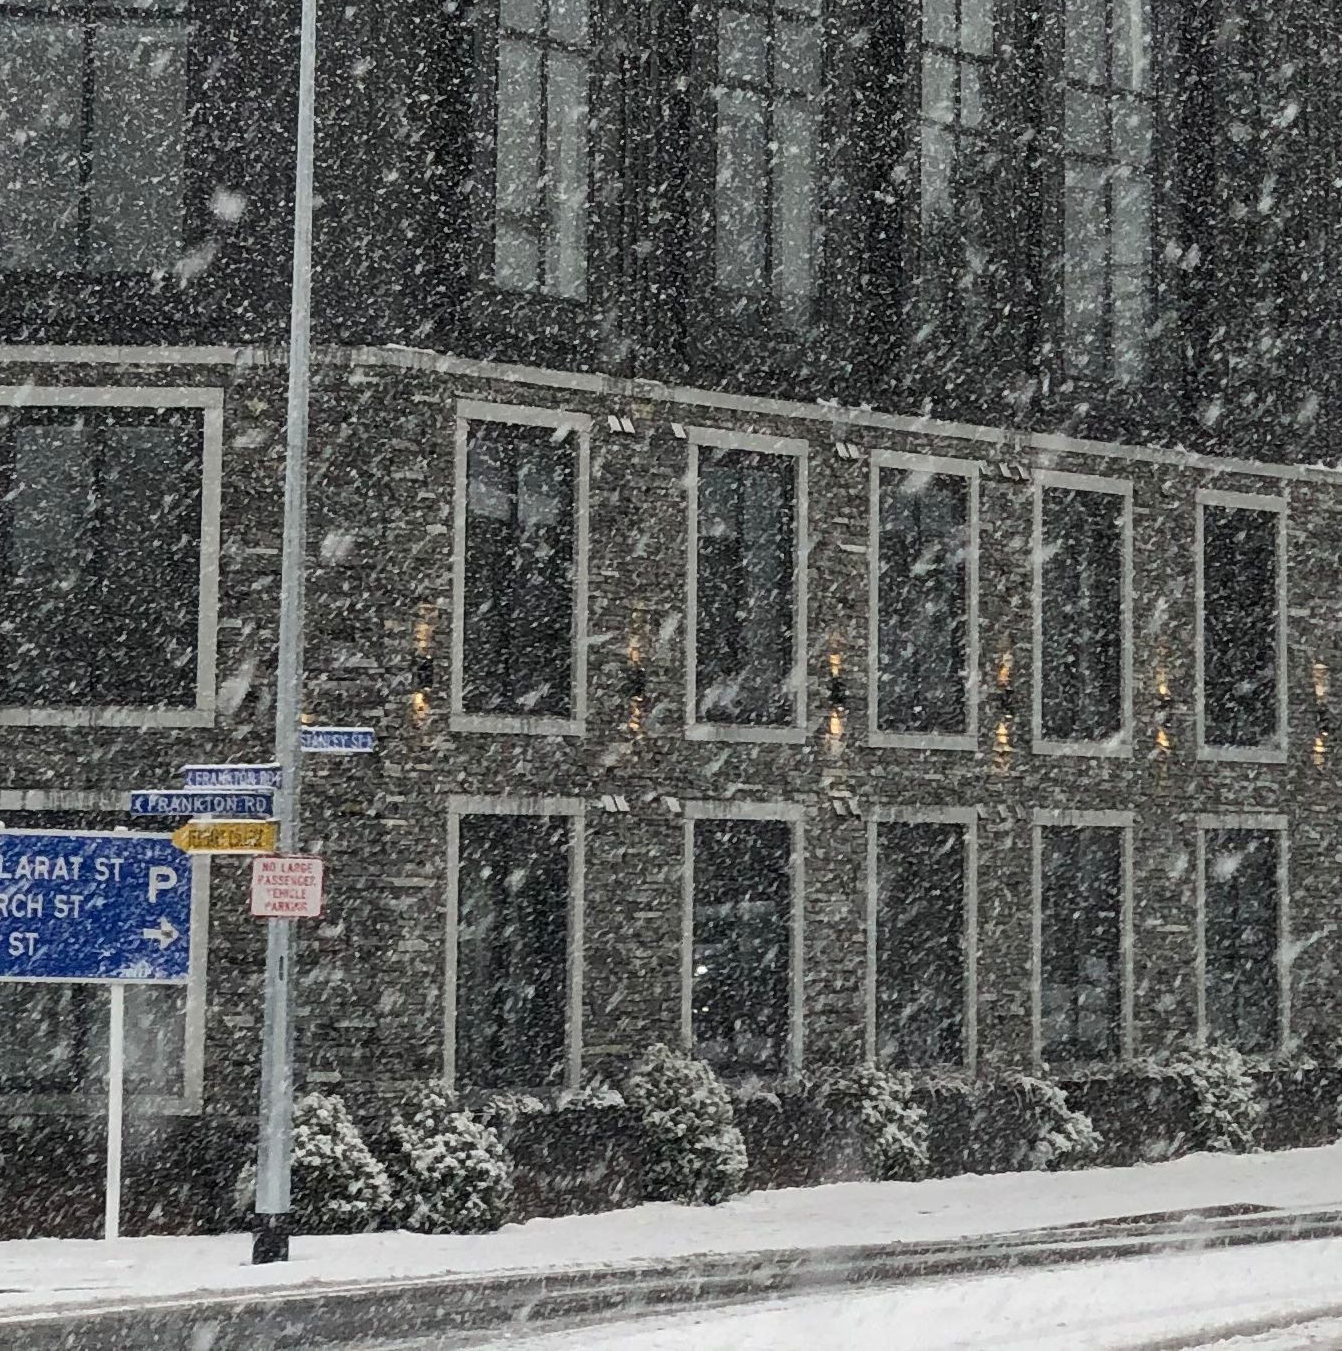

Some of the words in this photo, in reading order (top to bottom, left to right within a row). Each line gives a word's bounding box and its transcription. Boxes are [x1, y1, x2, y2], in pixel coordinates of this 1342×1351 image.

[148, 793, 238, 813] FRANKTON
[244, 795, 268, 813] RD
[95, 857, 125, 882] ST
[262, 861, 276, 872] NO
[281, 862, 313, 874] LARGE
[148, 865, 179, 904] P
[258, 875, 317, 887] PASSENGER
[54, 894, 85, 919] ST
[8, 932, 39, 957] ST
